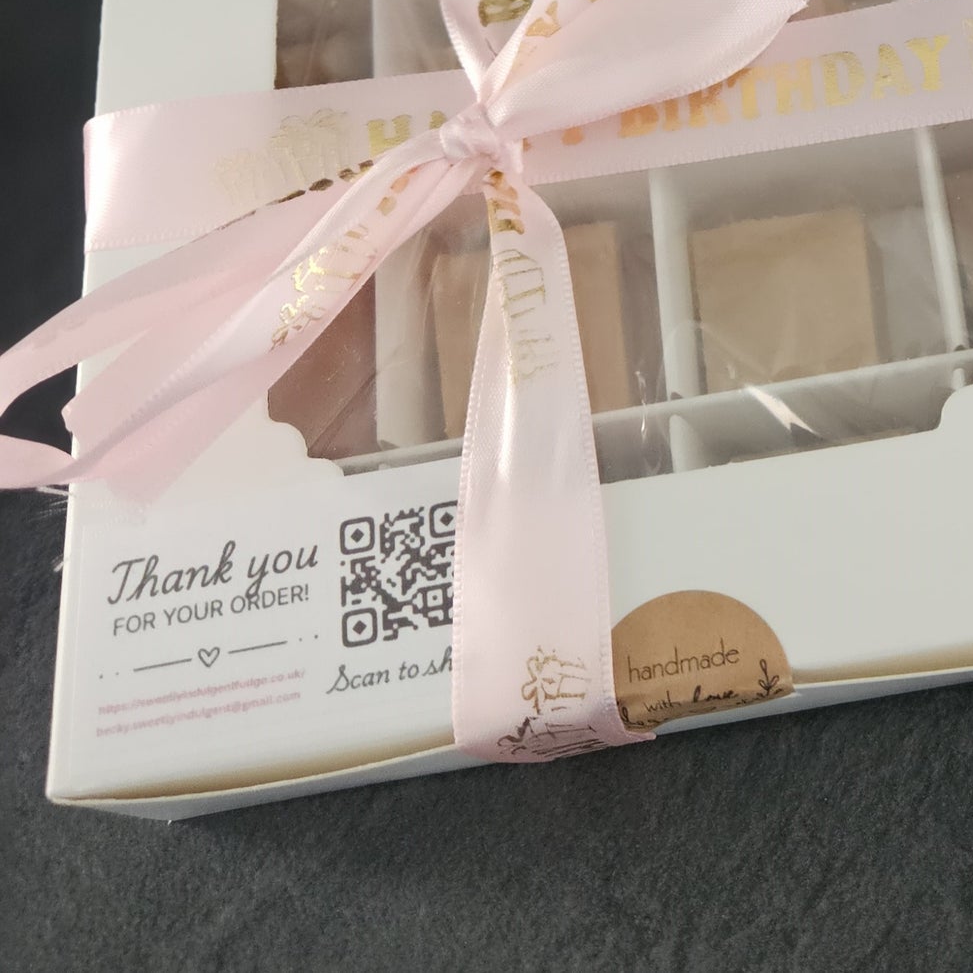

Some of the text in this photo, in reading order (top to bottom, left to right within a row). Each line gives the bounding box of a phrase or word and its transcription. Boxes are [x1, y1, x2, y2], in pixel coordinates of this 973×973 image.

[107, 540, 319, 606] Thank you
[113, 583, 310, 637] FOR YOUR ORDER!
[326, 663, 391, 695] Scan
[398, 660, 420, 681] to
[627, 637, 740, 684] handmade
[643, 689, 682, 713] with
